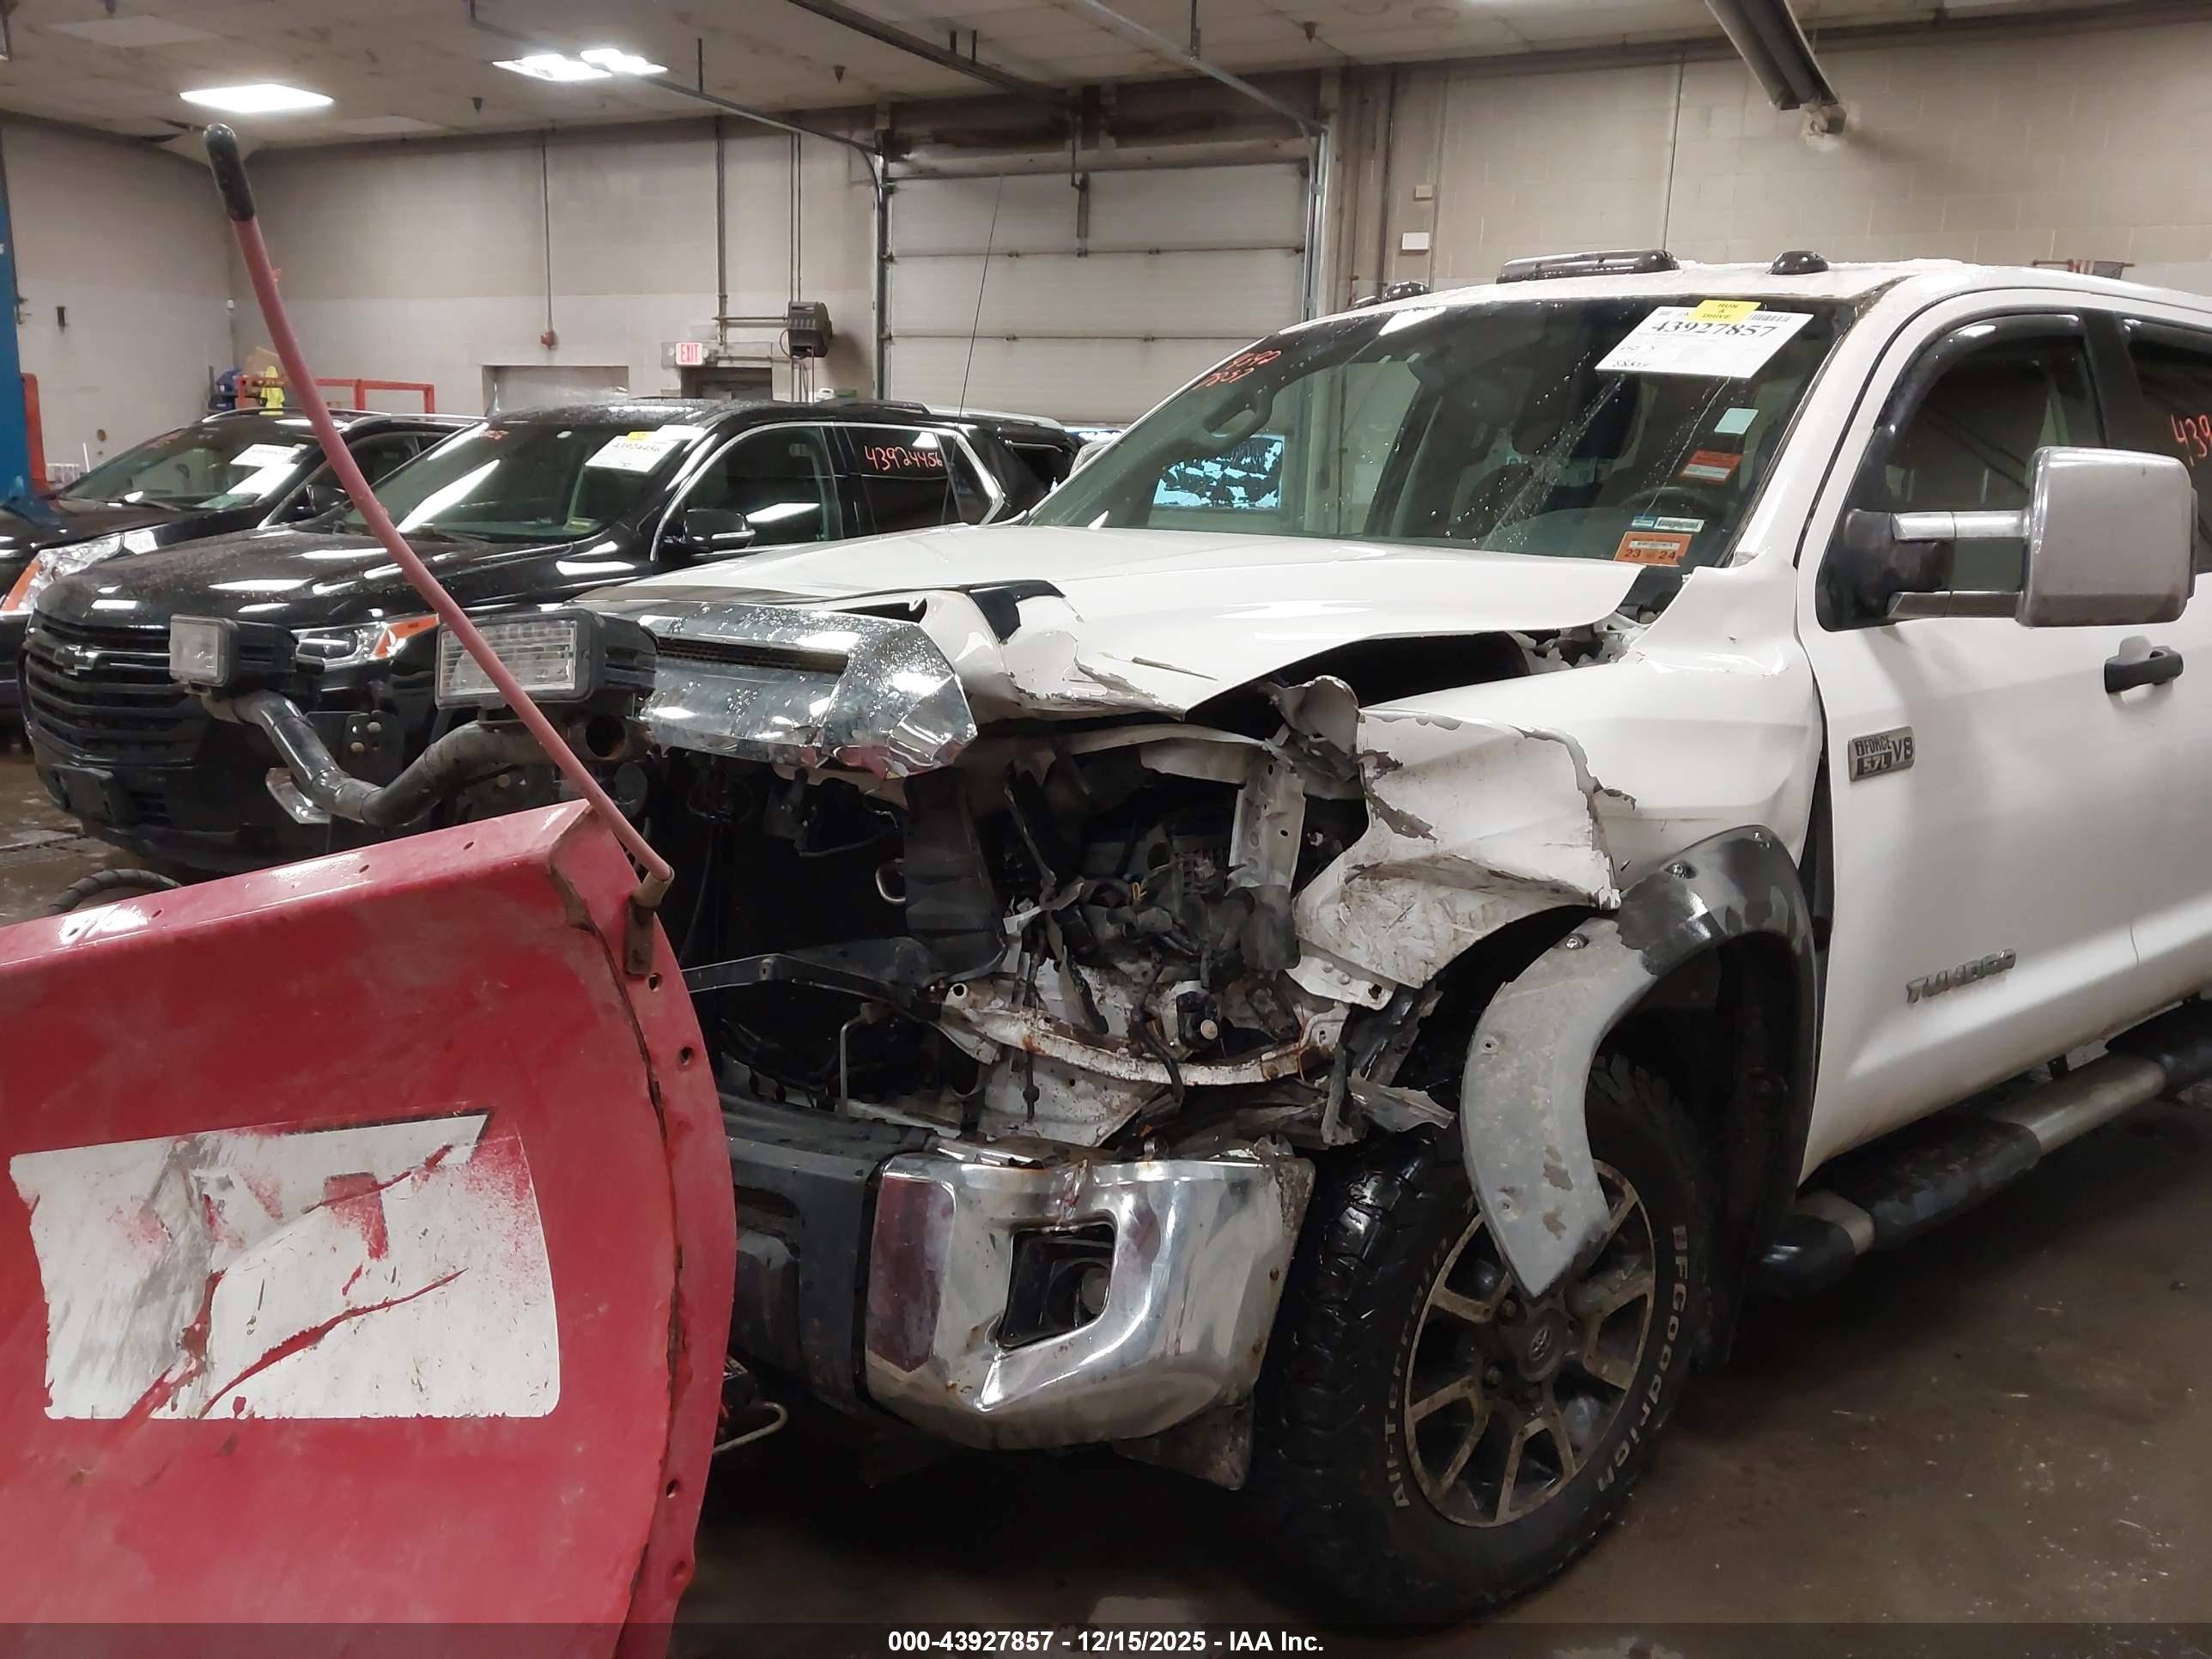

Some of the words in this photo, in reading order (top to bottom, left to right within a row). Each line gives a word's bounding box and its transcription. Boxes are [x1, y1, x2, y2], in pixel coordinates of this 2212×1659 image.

[1651, 320, 1778, 337] 43927857
[681, 343, 699, 362] EXIT
[864, 446, 944, 471] 43924456
[1624, 549, 1642, 558] 23
[1658, 550, 1677, 560] 24
[1892, 736, 1913, 762] V8
